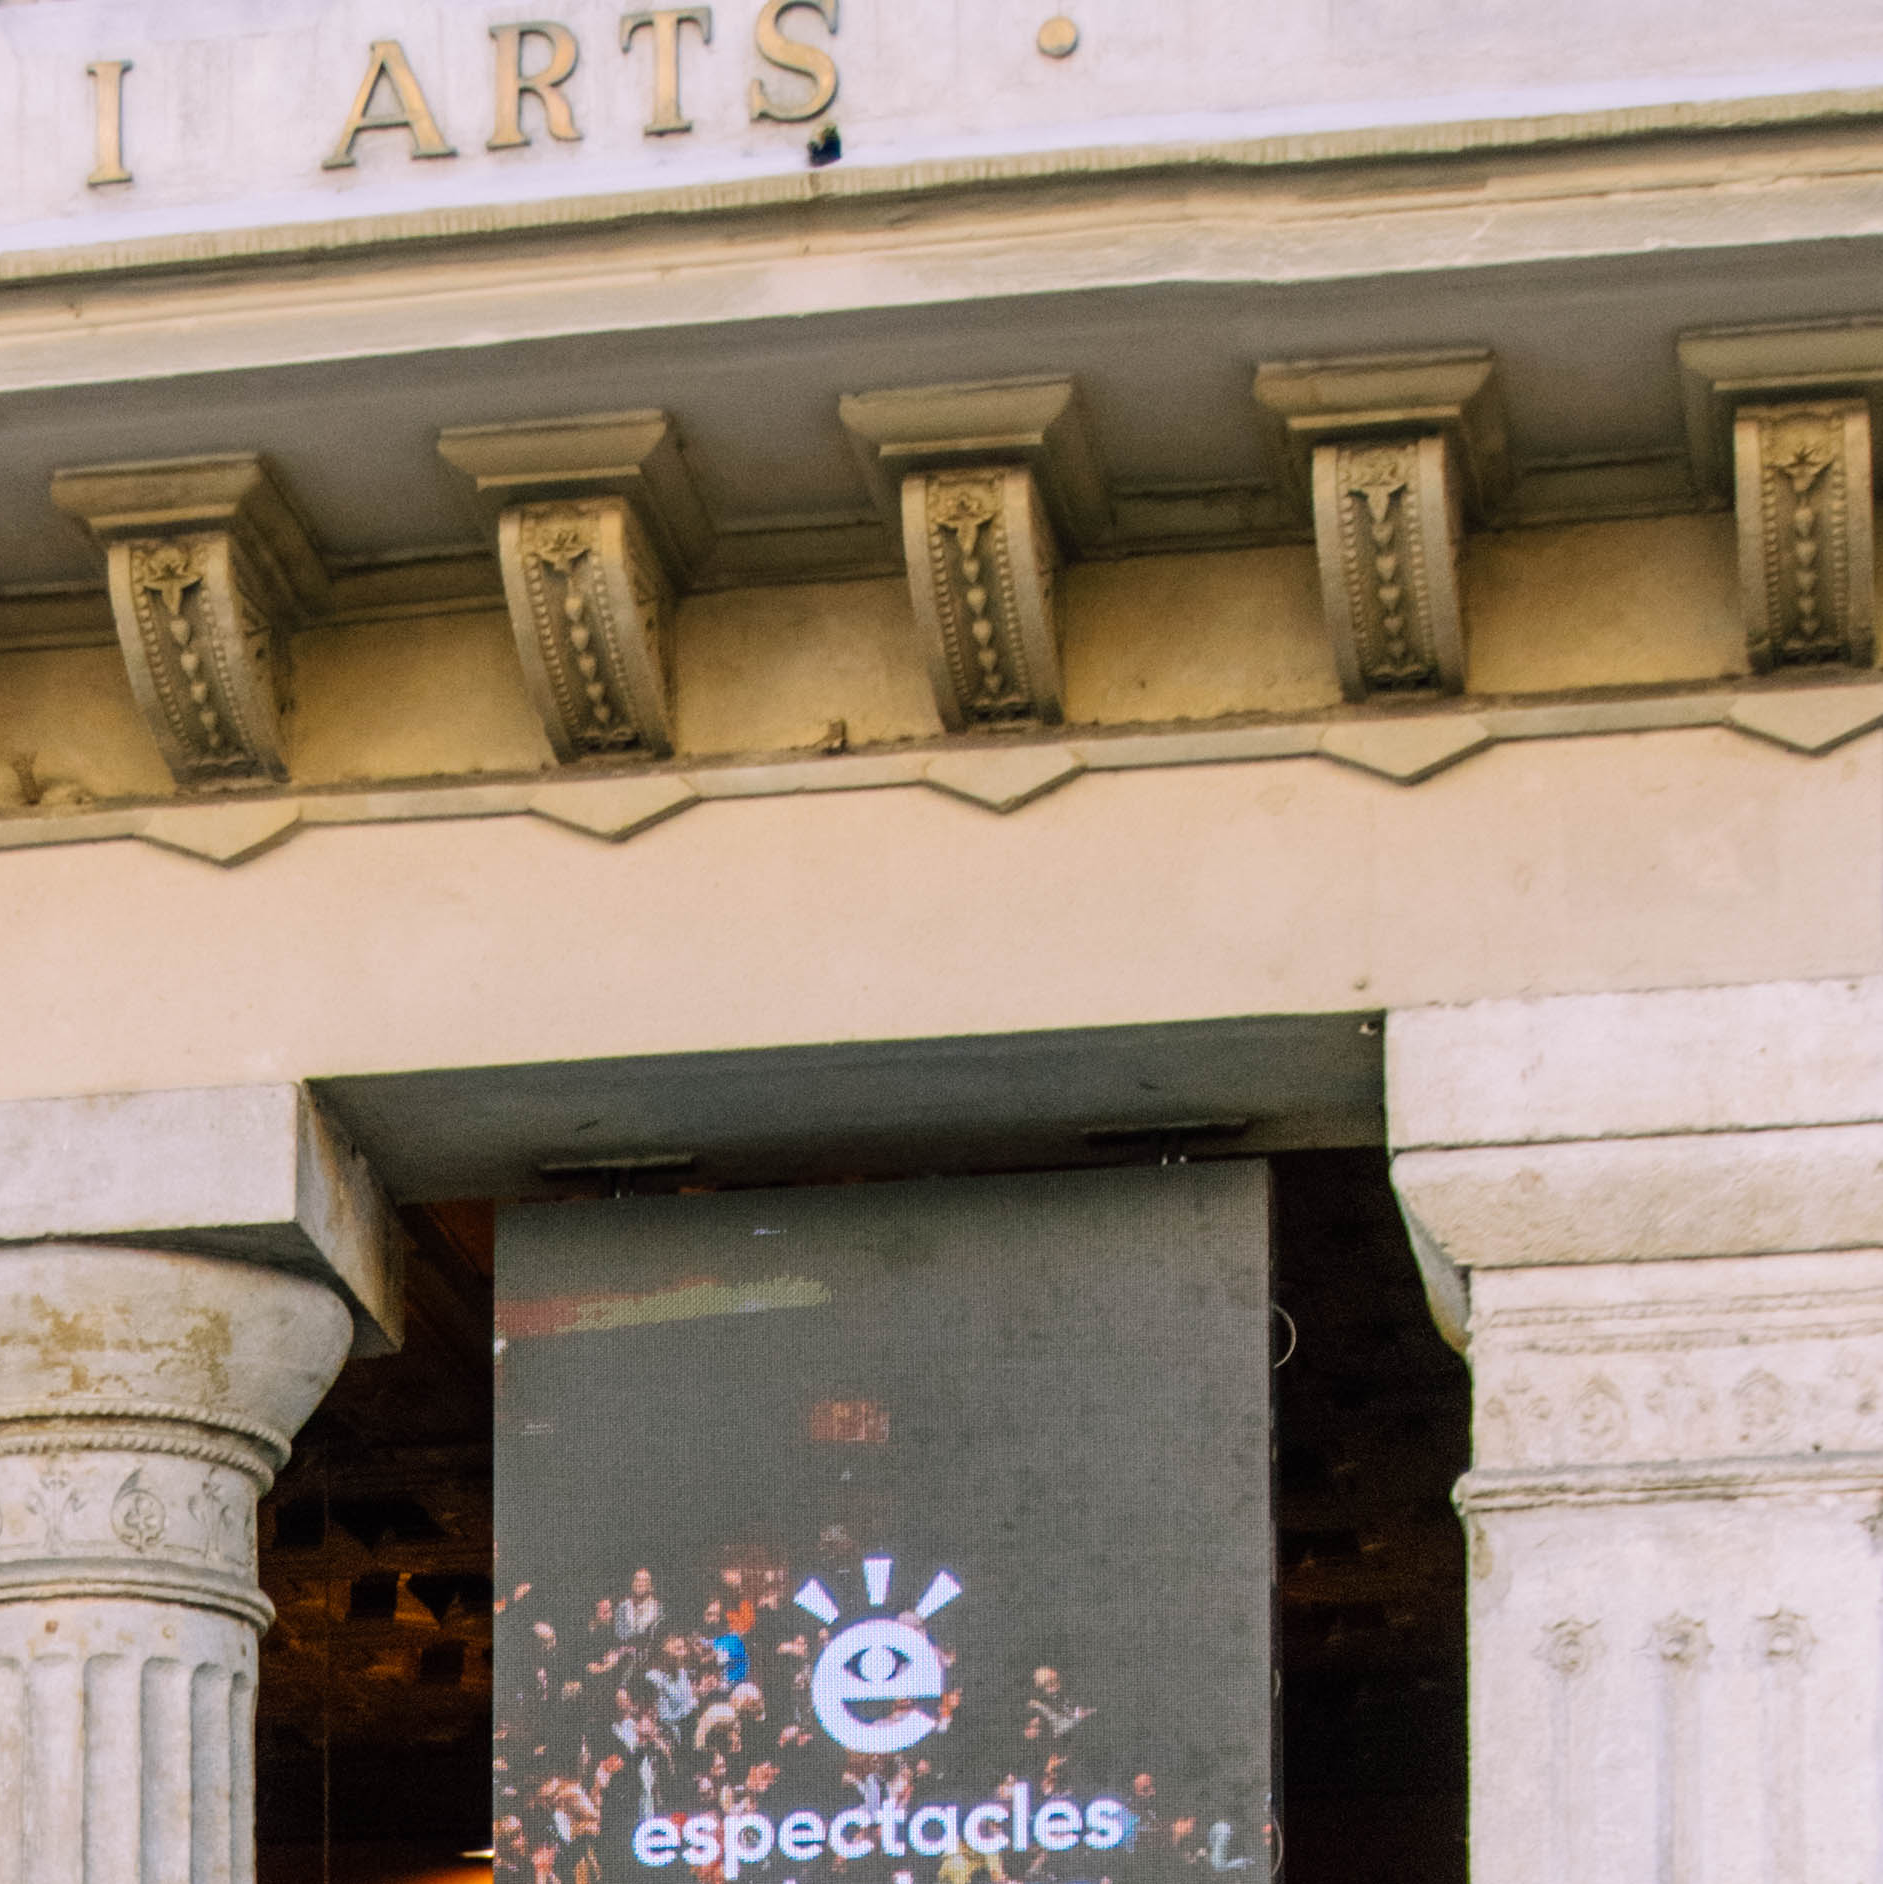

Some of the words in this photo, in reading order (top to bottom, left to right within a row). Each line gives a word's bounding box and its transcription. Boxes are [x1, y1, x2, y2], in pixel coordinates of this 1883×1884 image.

[85, 59, 134, 188] I
[320, 0, 842, 171] ARTS
[631, 1782, 1124, 1878] espectacles
